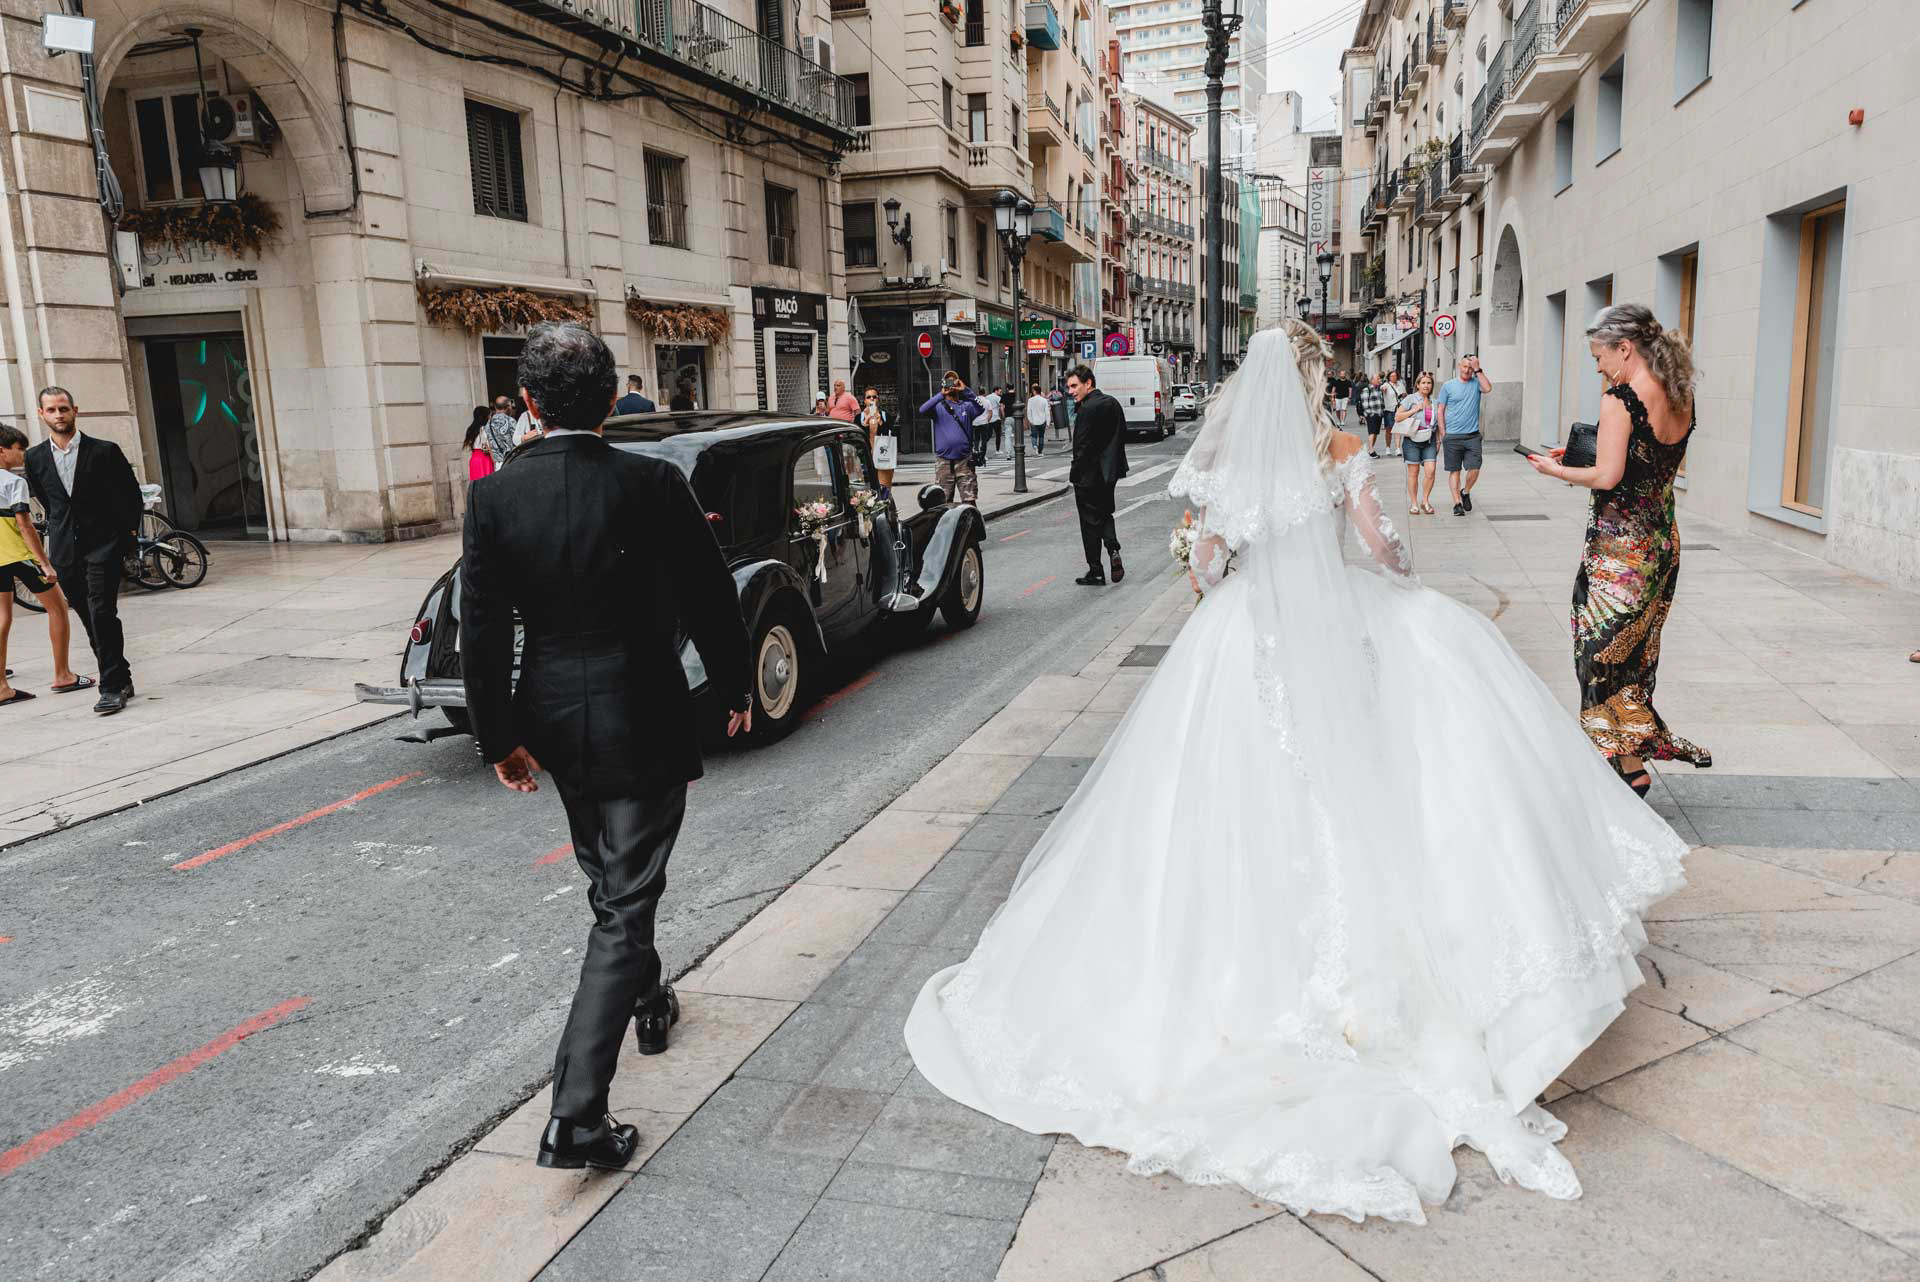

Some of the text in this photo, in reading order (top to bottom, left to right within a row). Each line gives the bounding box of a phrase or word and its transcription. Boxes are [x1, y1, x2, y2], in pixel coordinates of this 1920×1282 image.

[774, 295, 798, 314] RACÓ
[1438, 321, 1451, 331] 20
[1084, 343, 1094, 358] P
